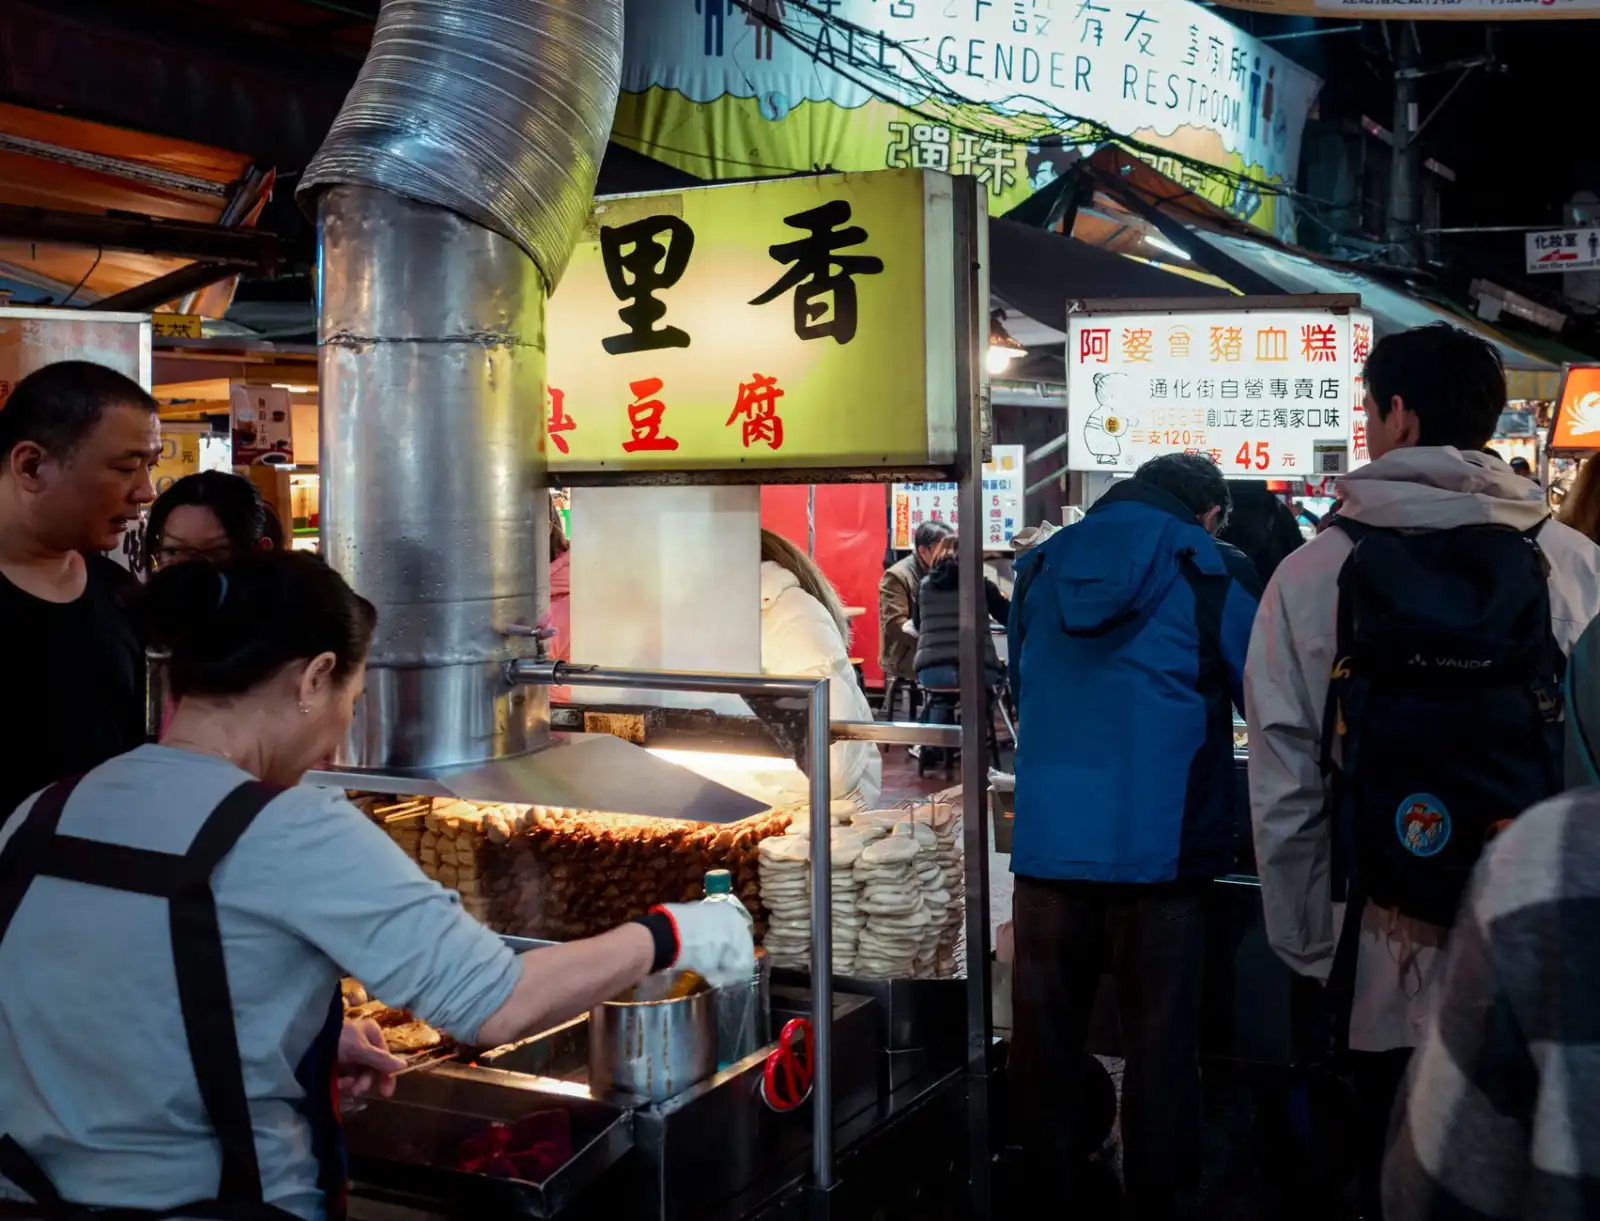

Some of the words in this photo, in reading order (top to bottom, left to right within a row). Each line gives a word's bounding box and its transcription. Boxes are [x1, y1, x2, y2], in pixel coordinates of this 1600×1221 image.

[813, 25, 896, 70] ALL
[936, 35, 1092, 93] GENDER
[1123, 64, 1241, 133] RESTROOM
[600, 200, 885, 355] 里香
[1149, 378, 1340, 399] 通化街自營專賣店
[1131, 429, 1207, 445] 三支120元
[1236, 440, 1270, 470] 45
[1282, 453, 1296, 467] 元
[1435, 656, 1493, 669] VAUDE
